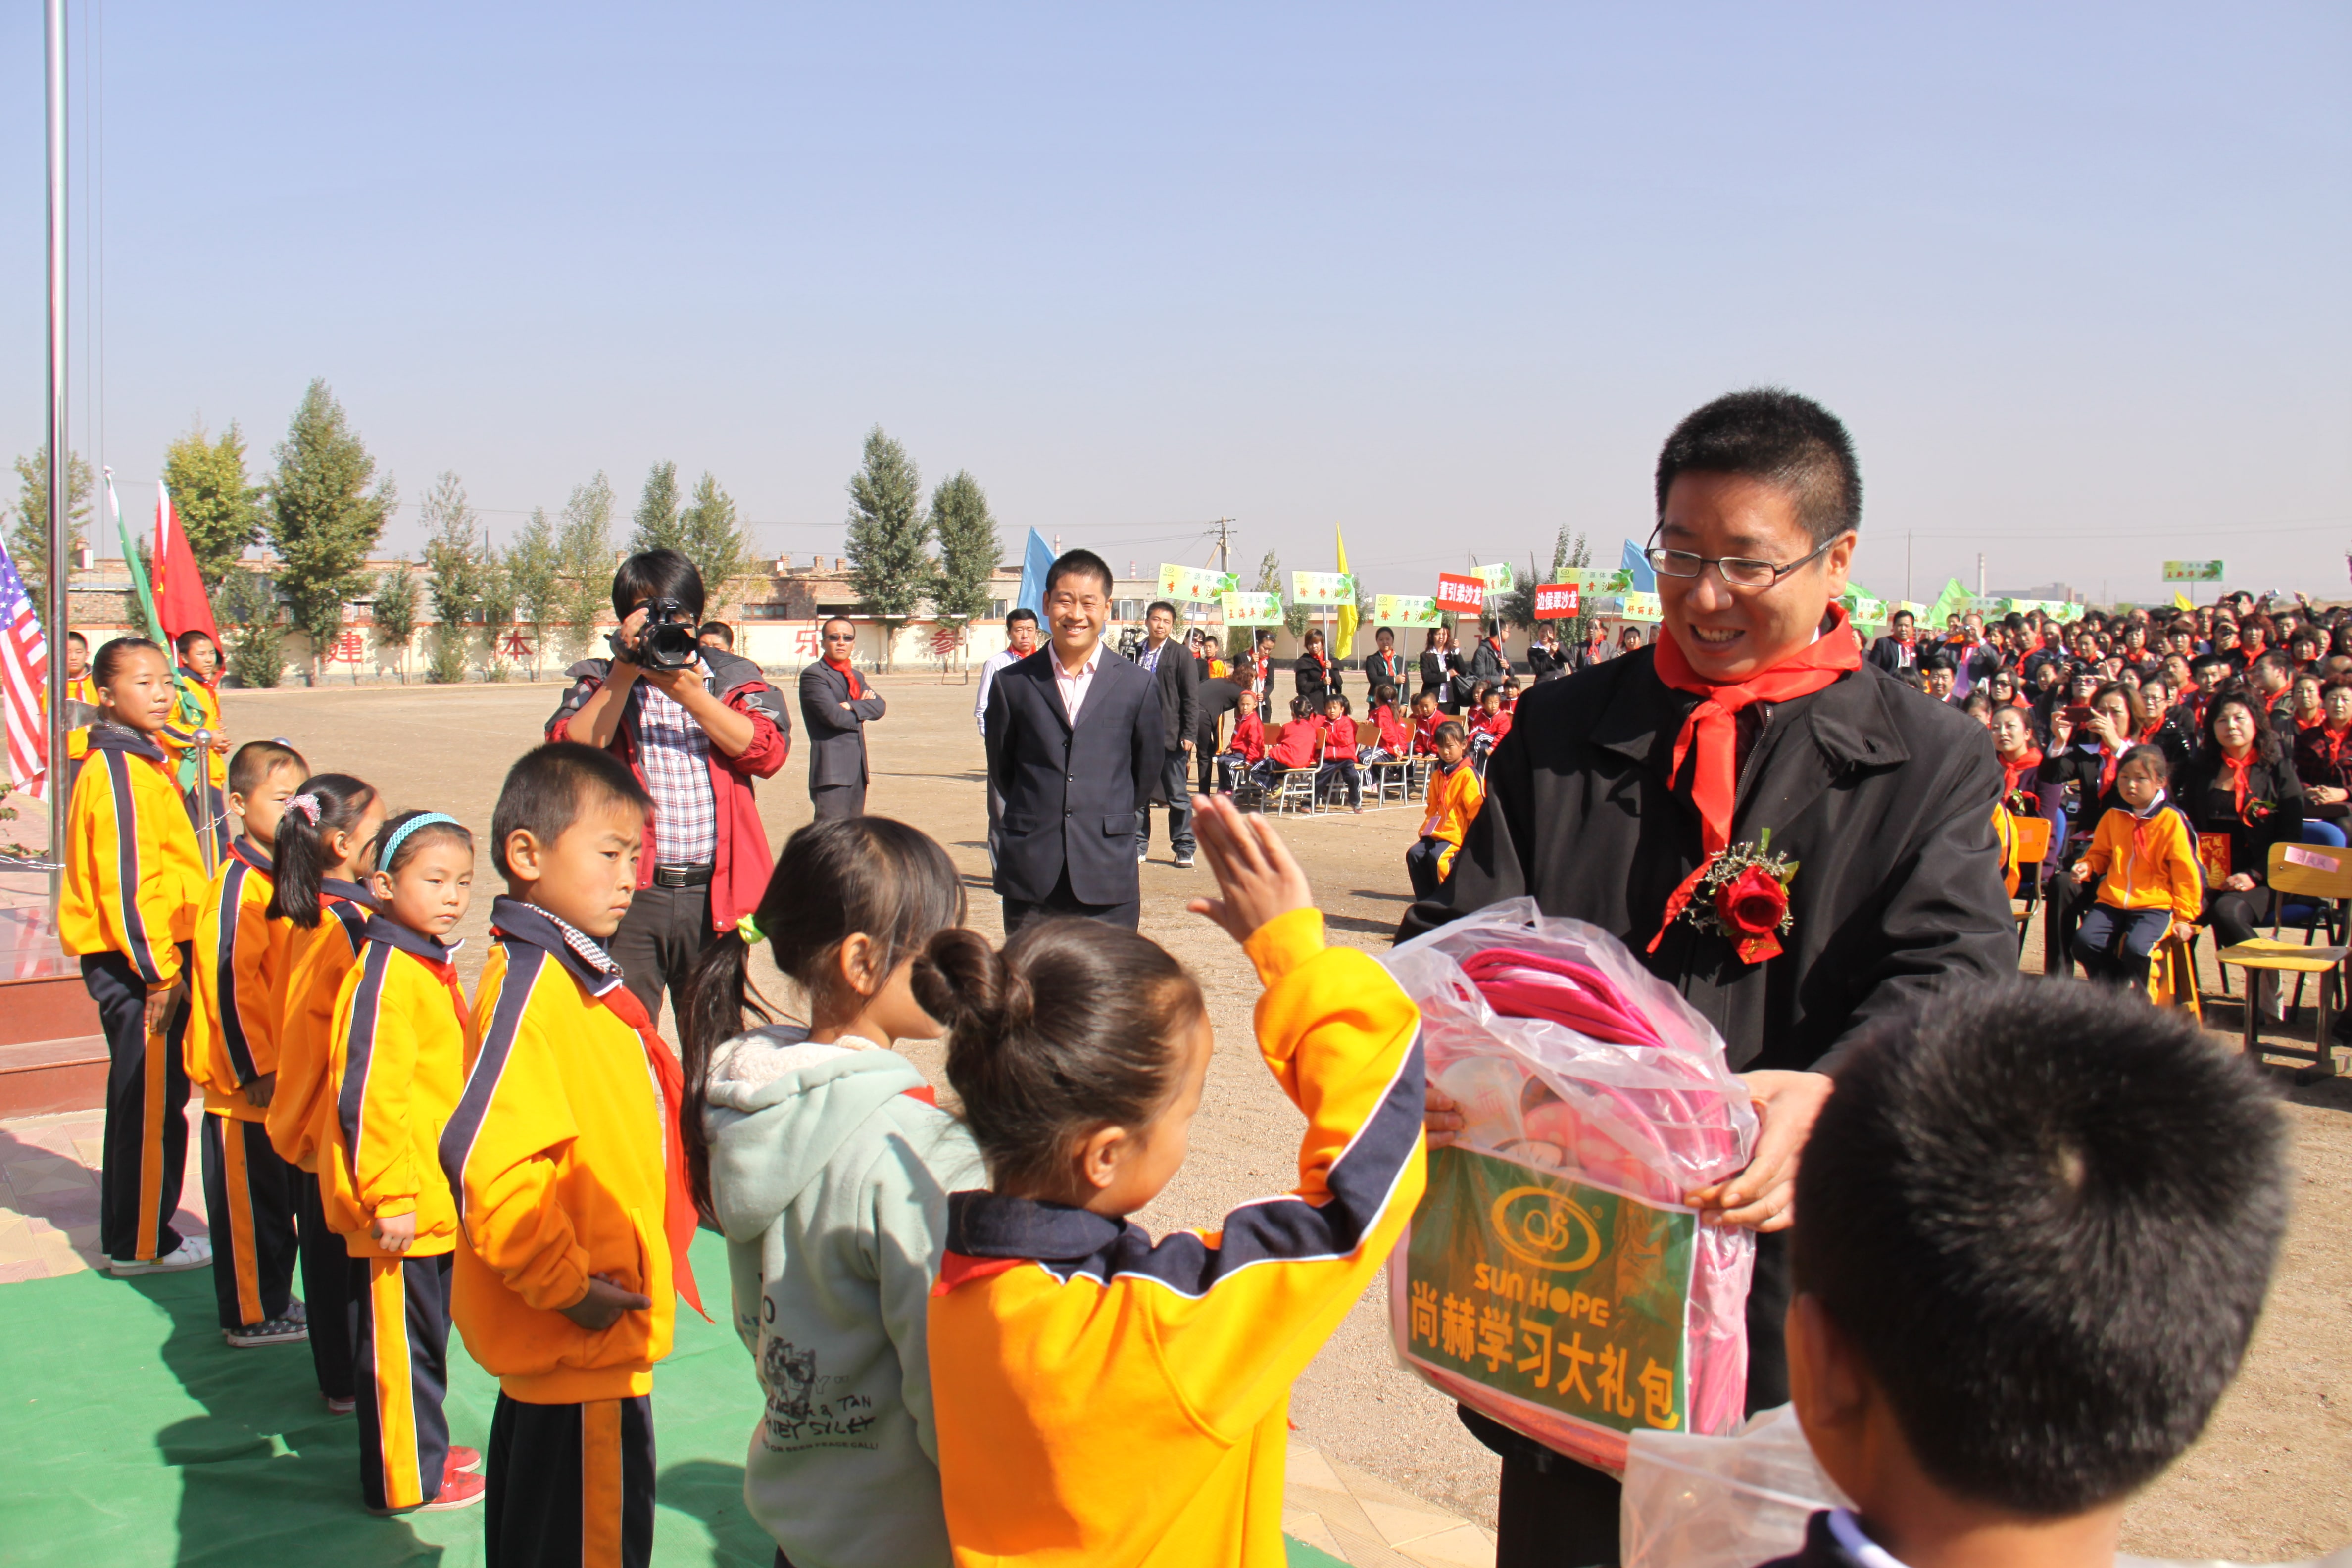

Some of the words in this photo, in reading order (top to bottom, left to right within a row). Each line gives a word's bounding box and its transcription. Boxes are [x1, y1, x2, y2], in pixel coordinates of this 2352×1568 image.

[1439, 581, 1481, 605] 董引弟沙龙
[321, 631, 365, 664] 建
[498, 630, 535, 662] 本
[1474, 1262, 1524, 1303] SUN
[1530, 1278, 1611, 1327] HOPE
[1411, 1280, 1680, 1430] 尚赫学习大礼包
